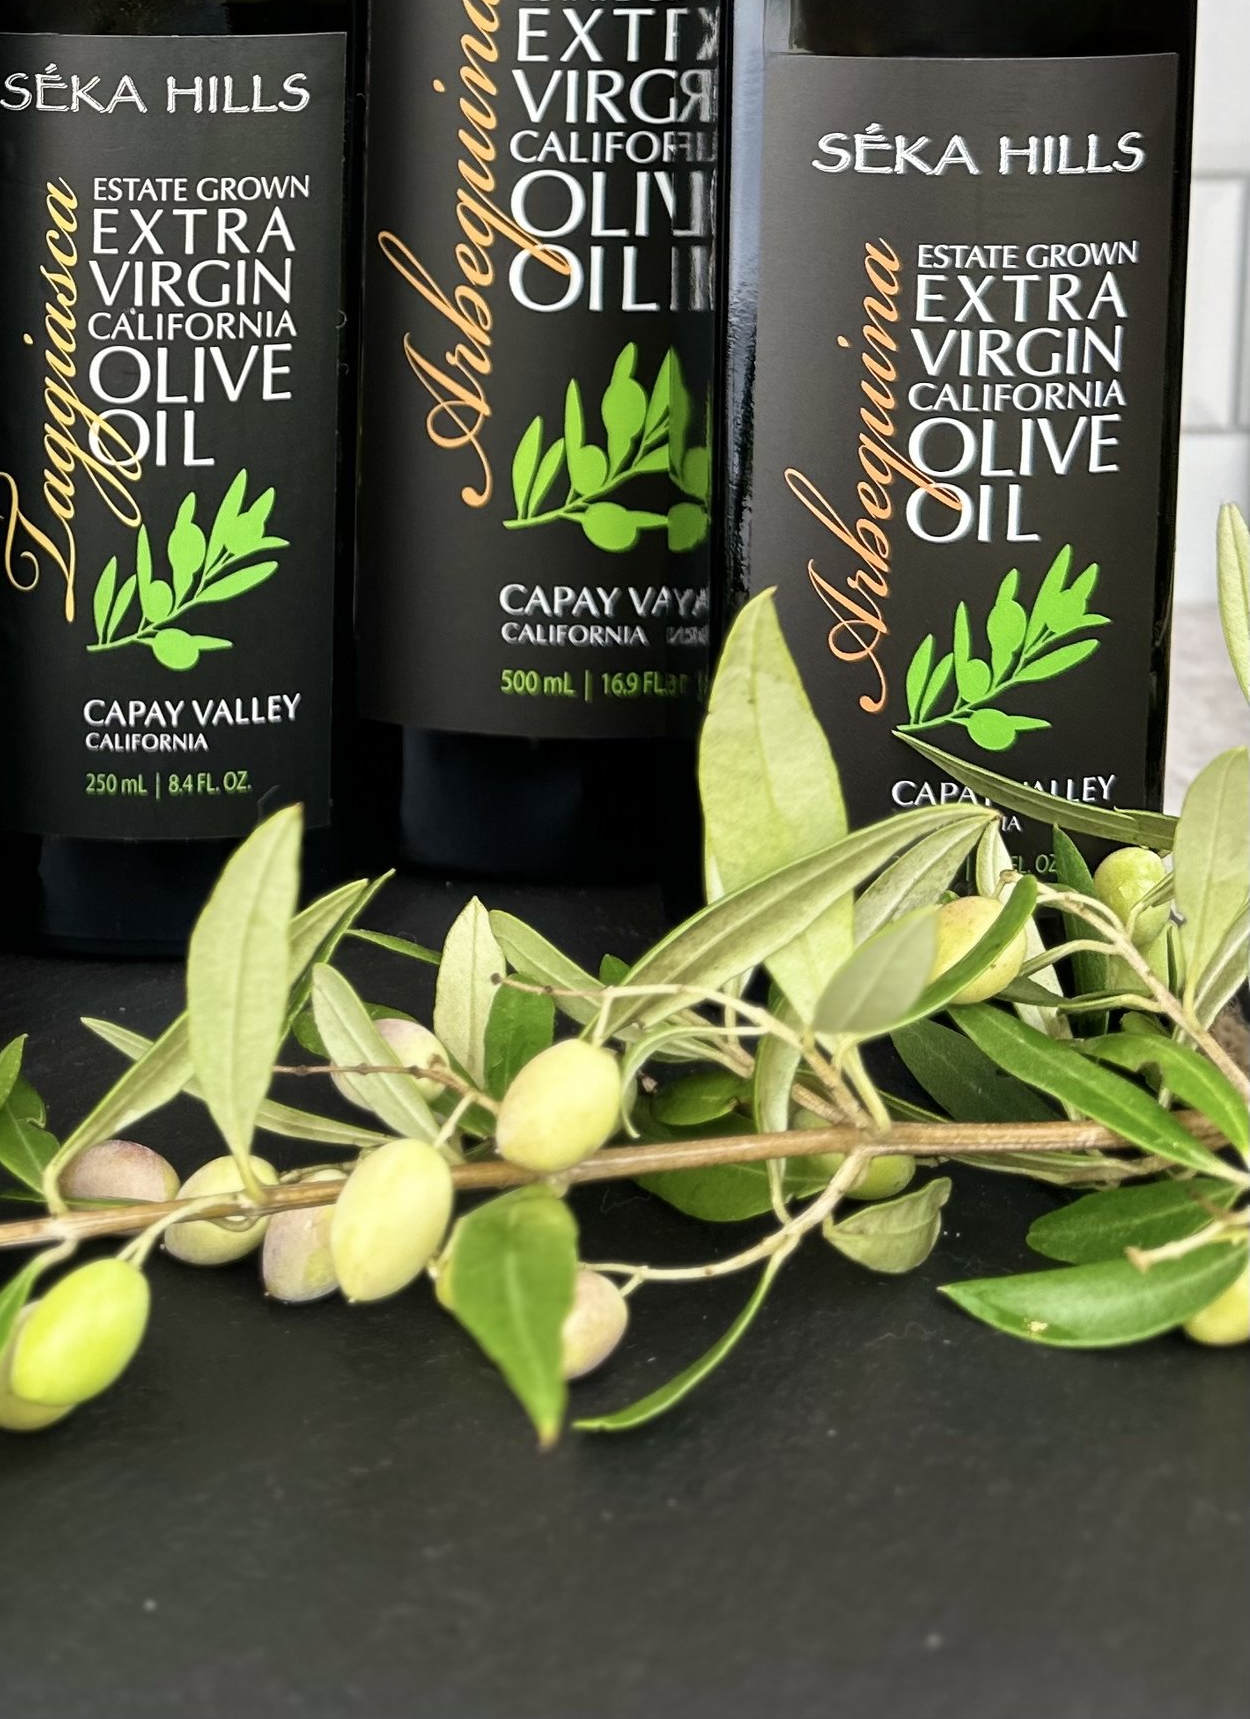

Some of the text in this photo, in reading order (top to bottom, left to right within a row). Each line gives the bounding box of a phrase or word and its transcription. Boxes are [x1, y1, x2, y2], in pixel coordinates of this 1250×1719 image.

[516, 7, 678, 63] EXT
[0, 62, 311, 114] SÉKA HILLS
[511, 68, 678, 124] VIRG
[509, 129, 675, 164] CALIFO
[811, 122, 1146, 176] SÉKA HILLS
[93, 174, 310, 202] ESTATE GROWN
[92, 205, 296, 256] EXTRA
[917, 240, 1138, 269] ESTATE GROWN
[88, 257, 292, 308] VIRGIN
[508, 239, 660, 313] OIL
[915, 270, 1128, 323] EXTRA
[87, 307, 298, 341] CALIFORNIA
[88, 343, 293, 405] OLIVE
[910, 324, 1124, 378] VIRGIN
[907, 378, 1127, 412] CALIFORNIA
[88, 405, 215, 467] OIL
[907, 411, 1121, 478] OLIVE
[784, 236, 963, 713] Arbequina
[905, 475, 1042, 544] OIL
[499, 583, 619, 618] CAPAY
[500, 621, 647, 646] CALIFORNIA
[501, 668, 542, 697] 500
[543, 673, 575, 696] mL
[83, 692, 302, 728] CAPAY VALLEY
[85, 731, 209, 752] CALIFORNIA
[87, 774, 117, 795] 250
[121, 779, 146, 795] mL
[168, 775, 193, 794] 8.4
[197, 773, 220, 794] FL.
[223, 770, 252, 793] OZ.
